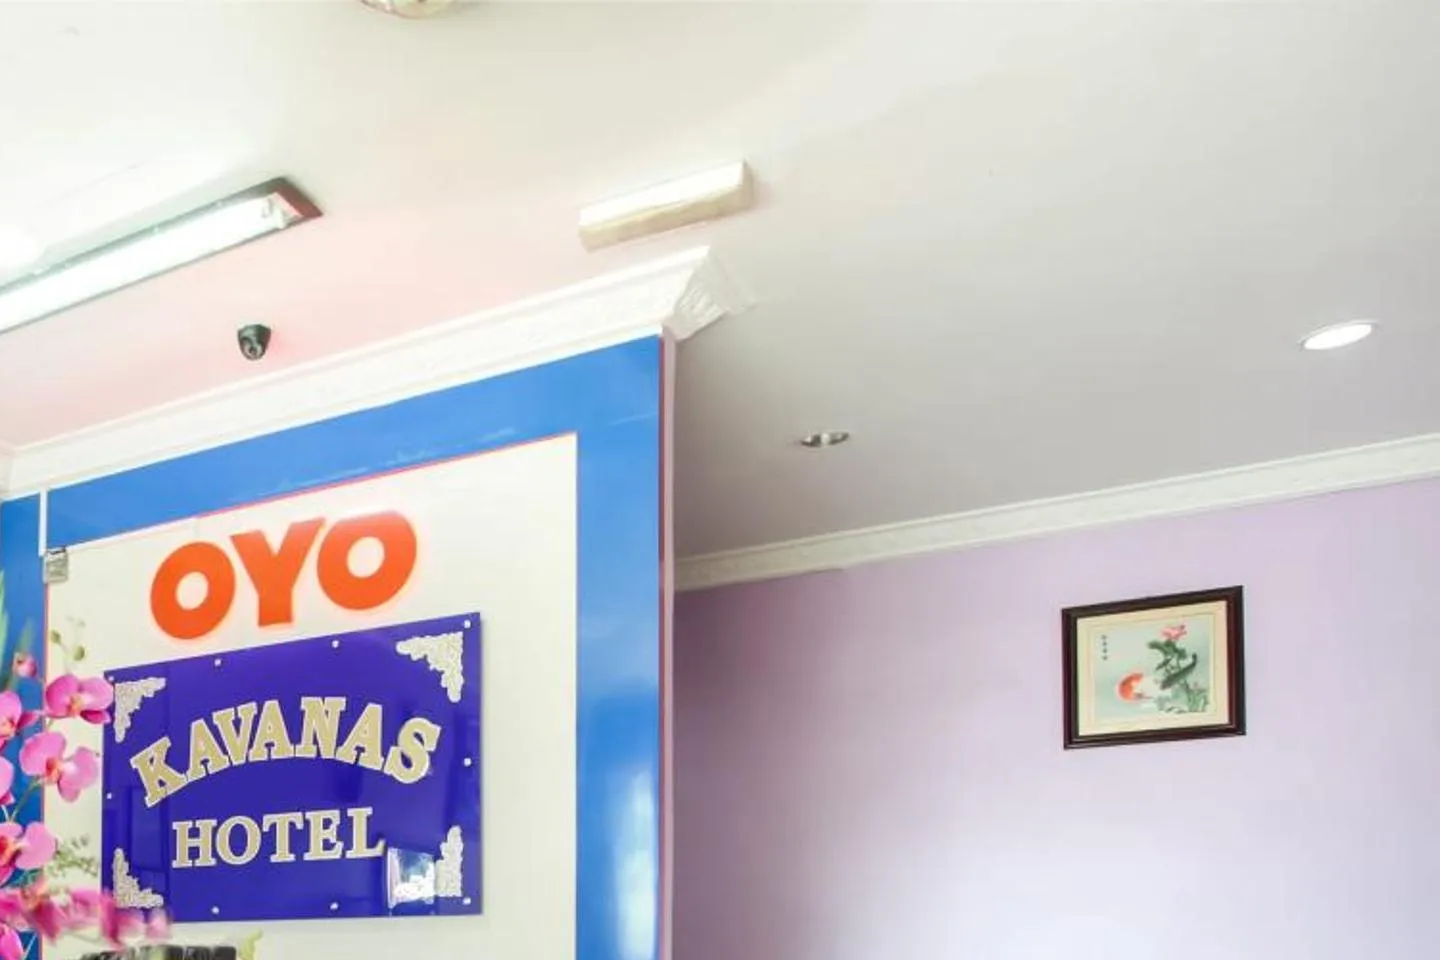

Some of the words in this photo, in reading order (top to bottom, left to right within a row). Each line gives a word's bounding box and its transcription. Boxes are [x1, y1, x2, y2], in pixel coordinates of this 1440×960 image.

[150, 510, 417, 641] OYO
[130, 696, 442, 808] KAVANAS
[171, 807, 387, 869] HOTEL
